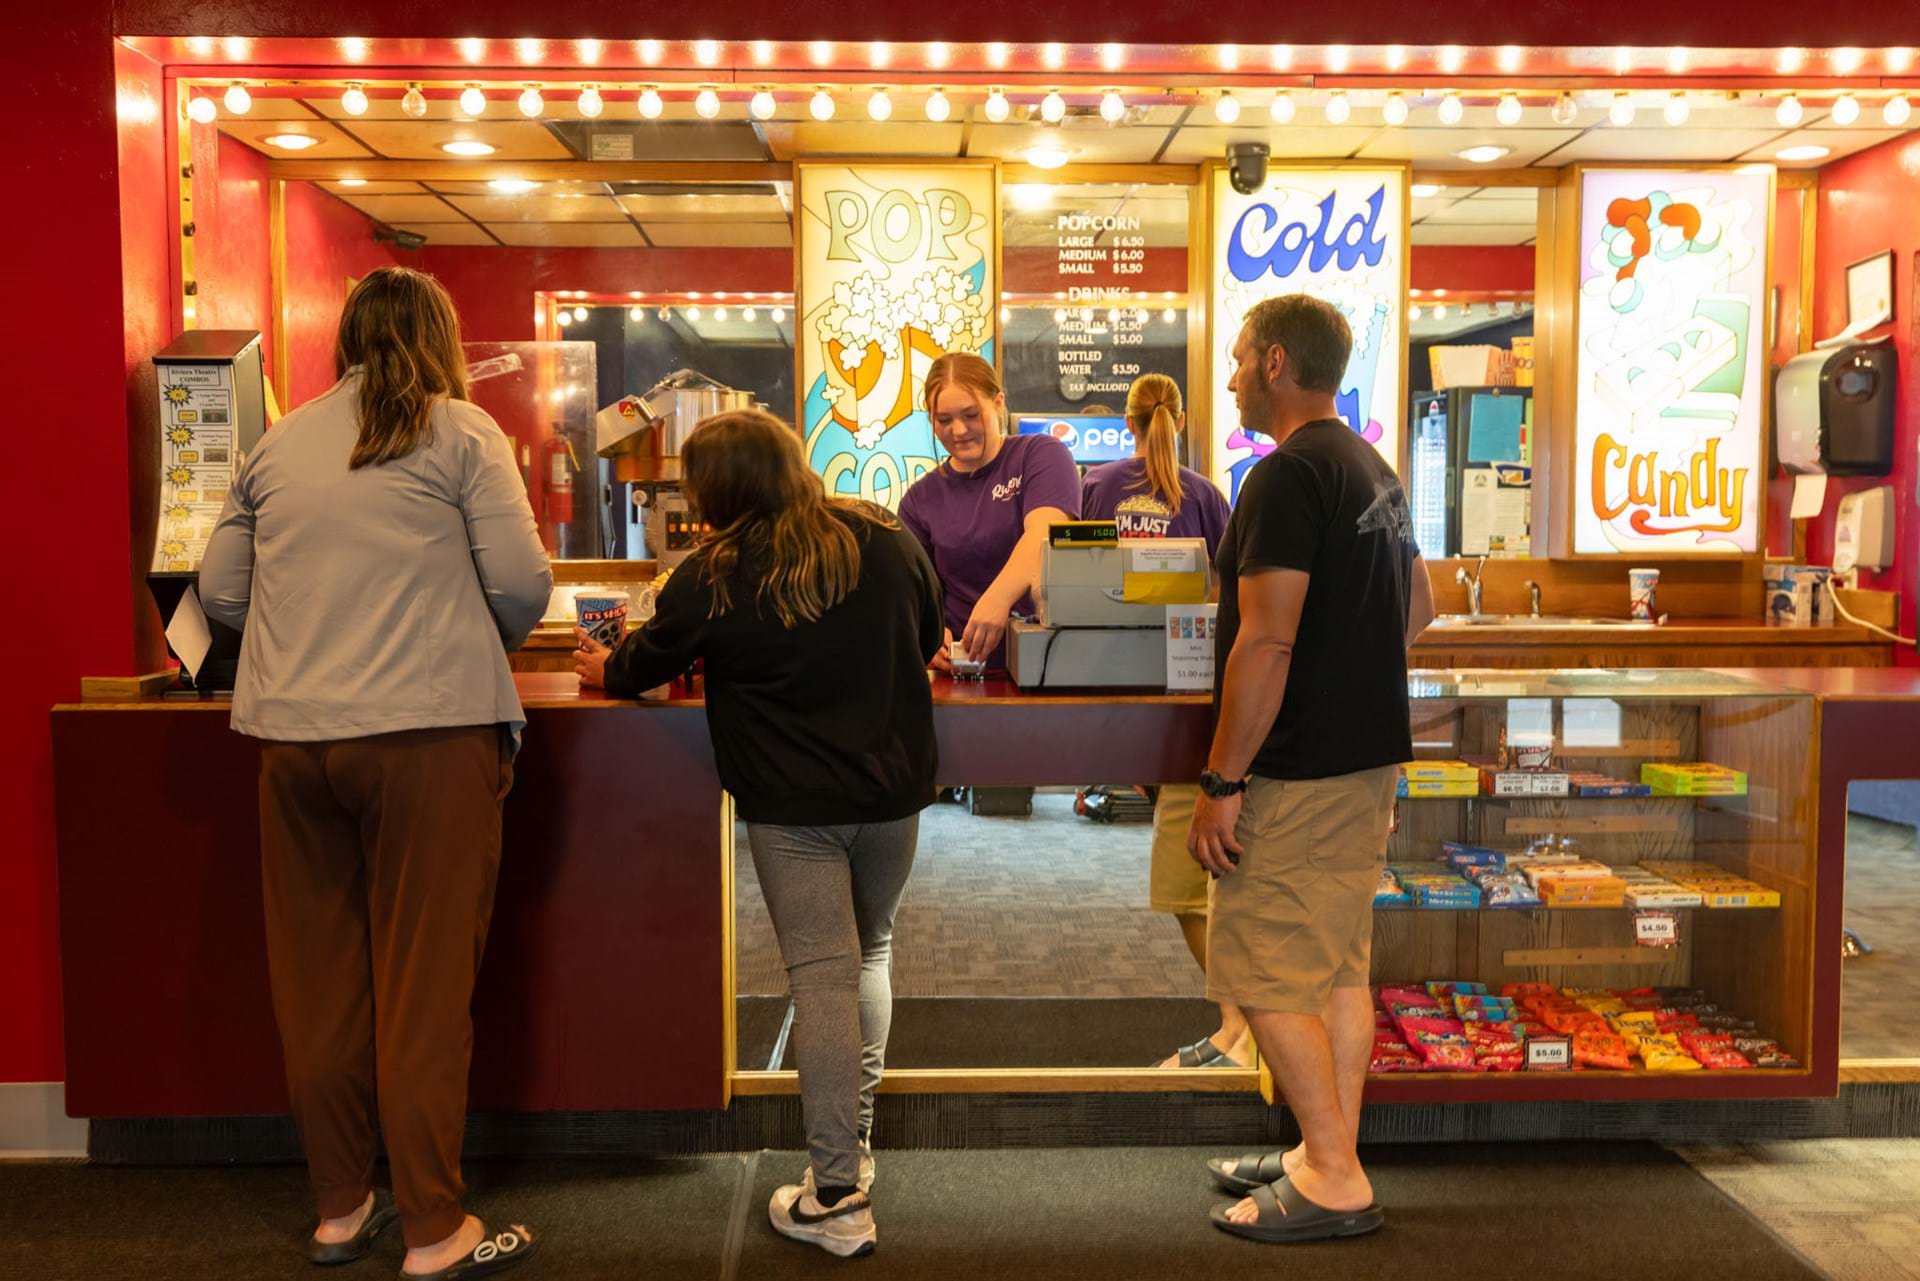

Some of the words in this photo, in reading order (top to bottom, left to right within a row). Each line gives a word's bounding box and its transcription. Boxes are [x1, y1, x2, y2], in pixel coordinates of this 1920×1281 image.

[824, 188, 972, 263] POP
[1057, 215, 1141, 231] POPCORN
[1227, 183, 1387, 282] Cold
[1058, 236, 1094, 247] LARGE
[1058, 249, 1107, 261] MEDIUM
[1058, 263, 1094, 274] SMALL
[1113, 263, 1143, 274] $5.50
[1058, 333, 1094, 345] SMALL
[1112, 333, 1143, 346] $5.00
[1058, 351, 1102, 362] BOTTLED
[1058, 364, 1092, 375] WATER
[1112, 364, 1140, 376] $3.50
[1069, 383, 1084, 392] TAX
[1086, 383, 1130, 392] INCLUDED
[1084, 427, 1135, 451] pep
[1591, 432, 1749, 535] Candy
[1133, 516, 1171, 535] JUST
[1536, 1048, 1562, 1057] $5.00
